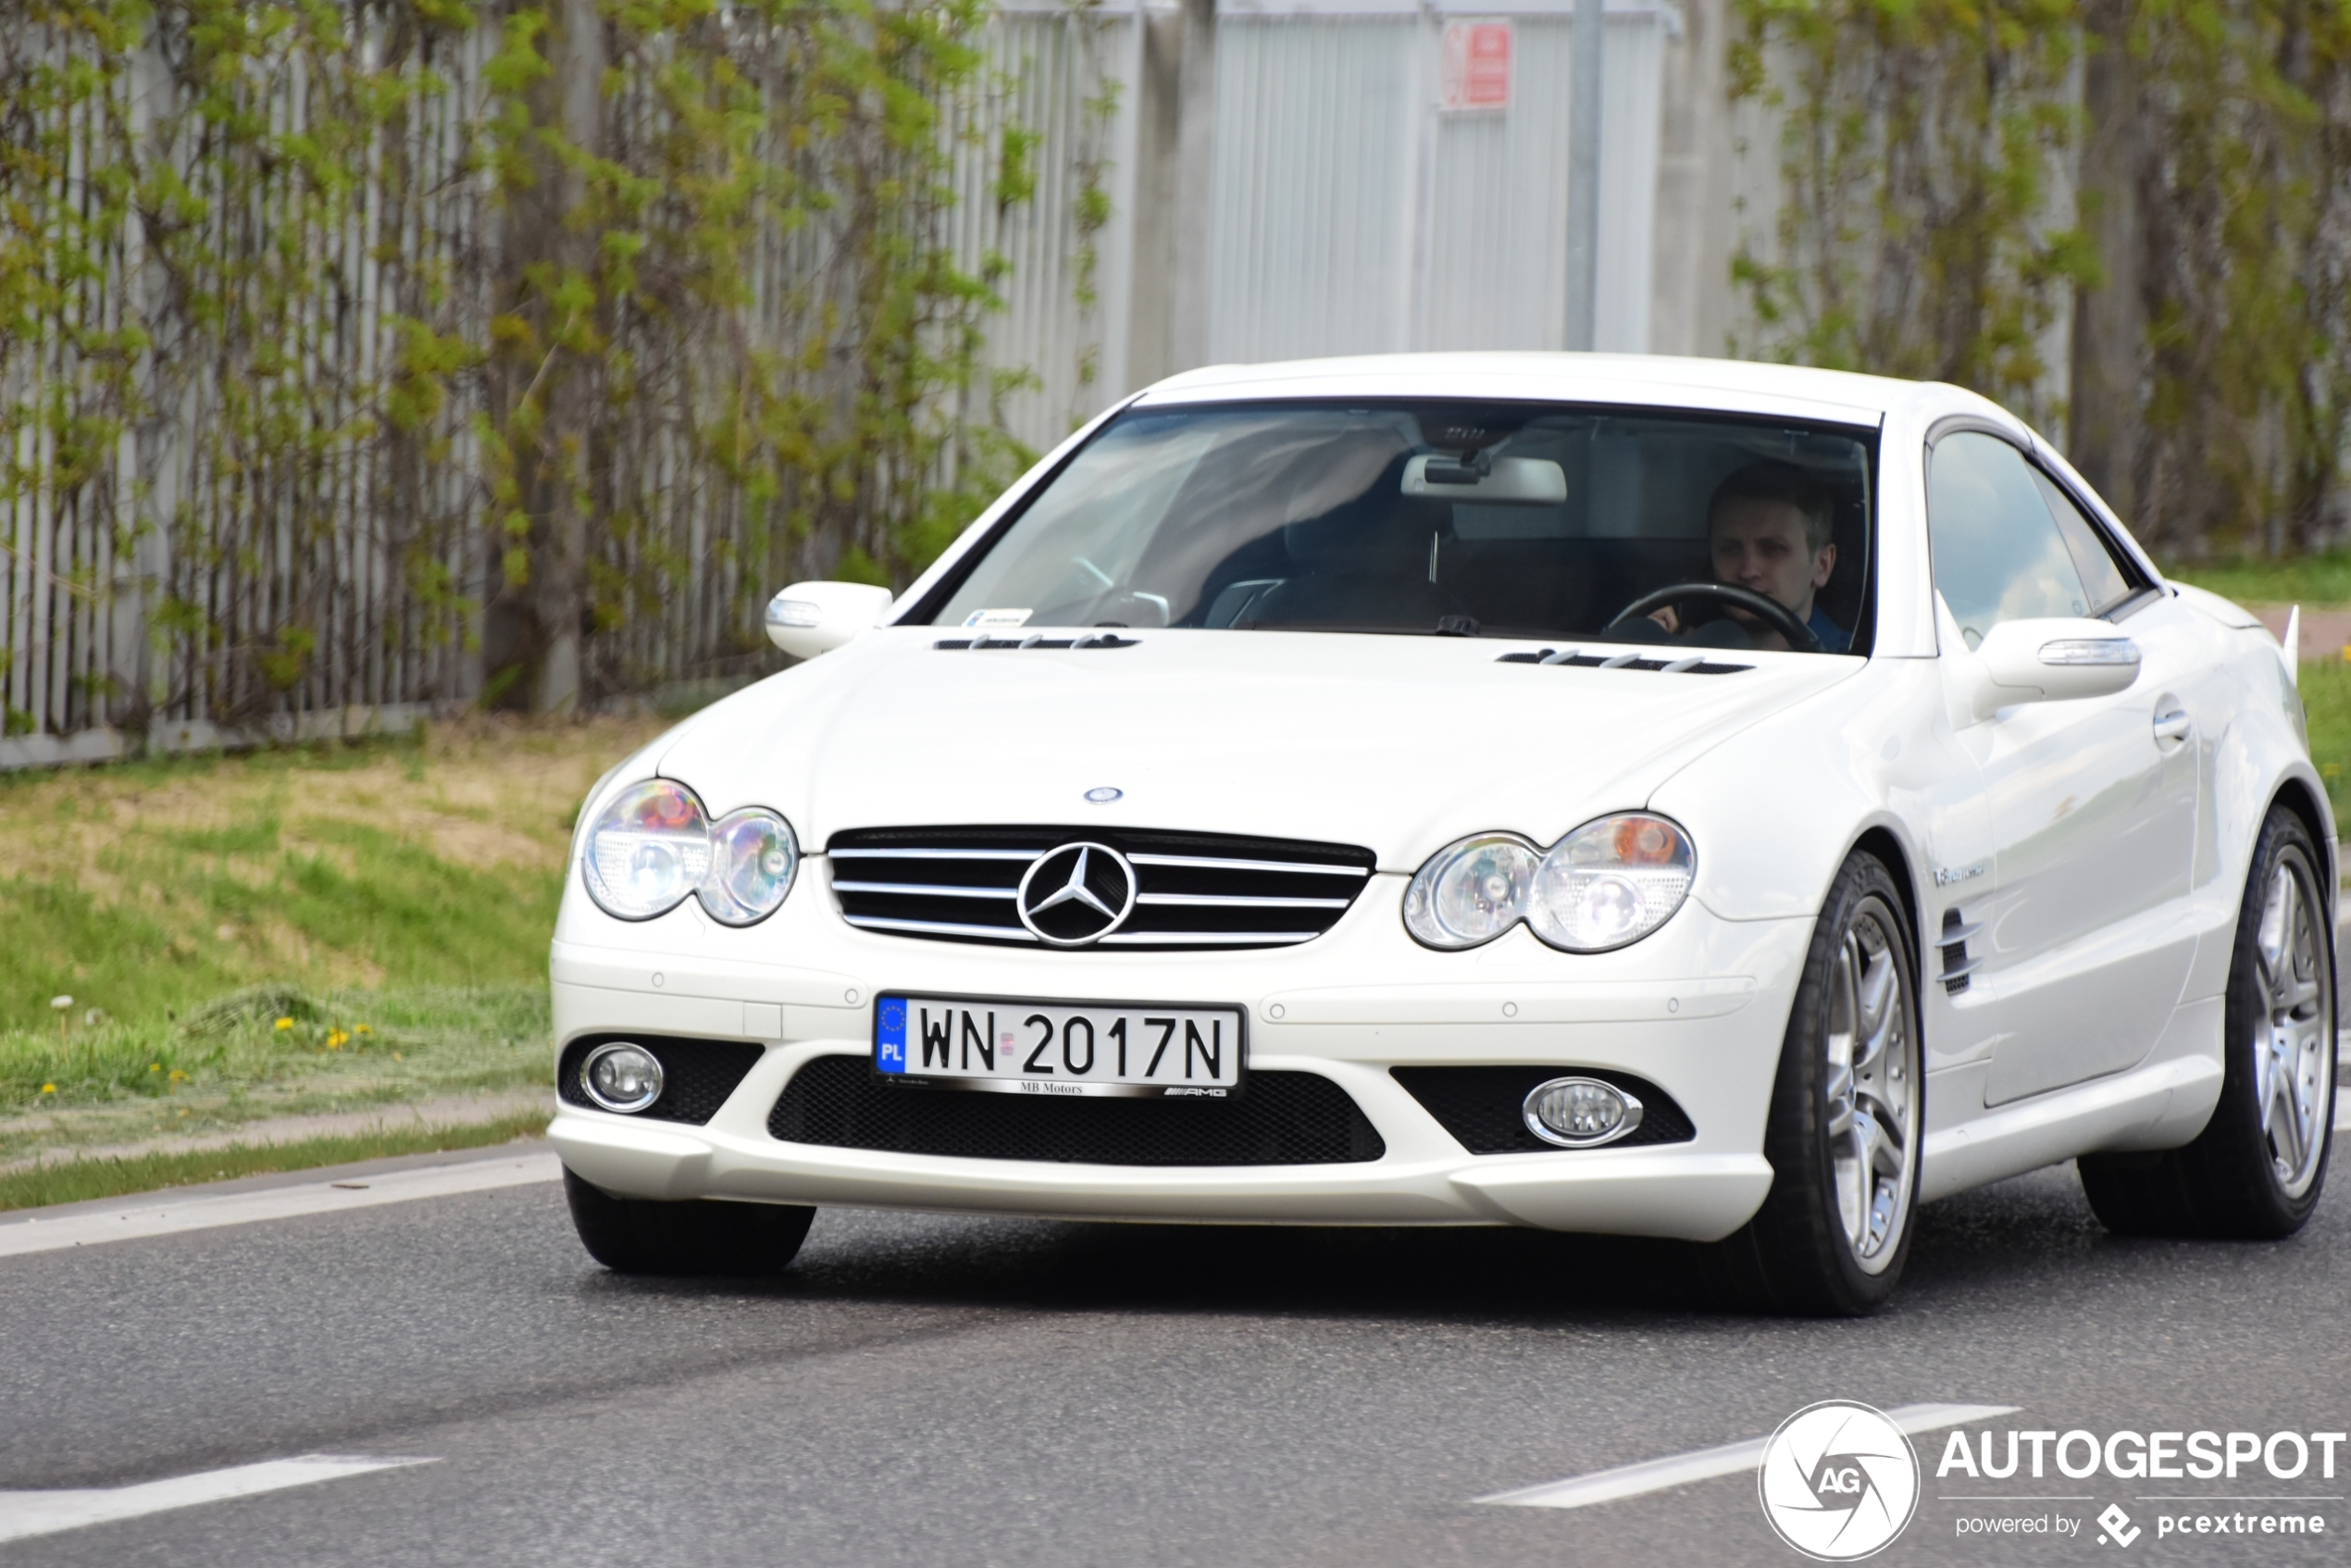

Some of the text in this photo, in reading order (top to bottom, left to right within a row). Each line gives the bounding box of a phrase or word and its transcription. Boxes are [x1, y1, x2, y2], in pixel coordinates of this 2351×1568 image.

[920, 1008, 1221, 1079] WN 2017N
[882, 1043, 902, 1061] PL
[1021, 1082, 1083, 1095] MB Motors
[1185, 1088, 1227, 1098] AMG
